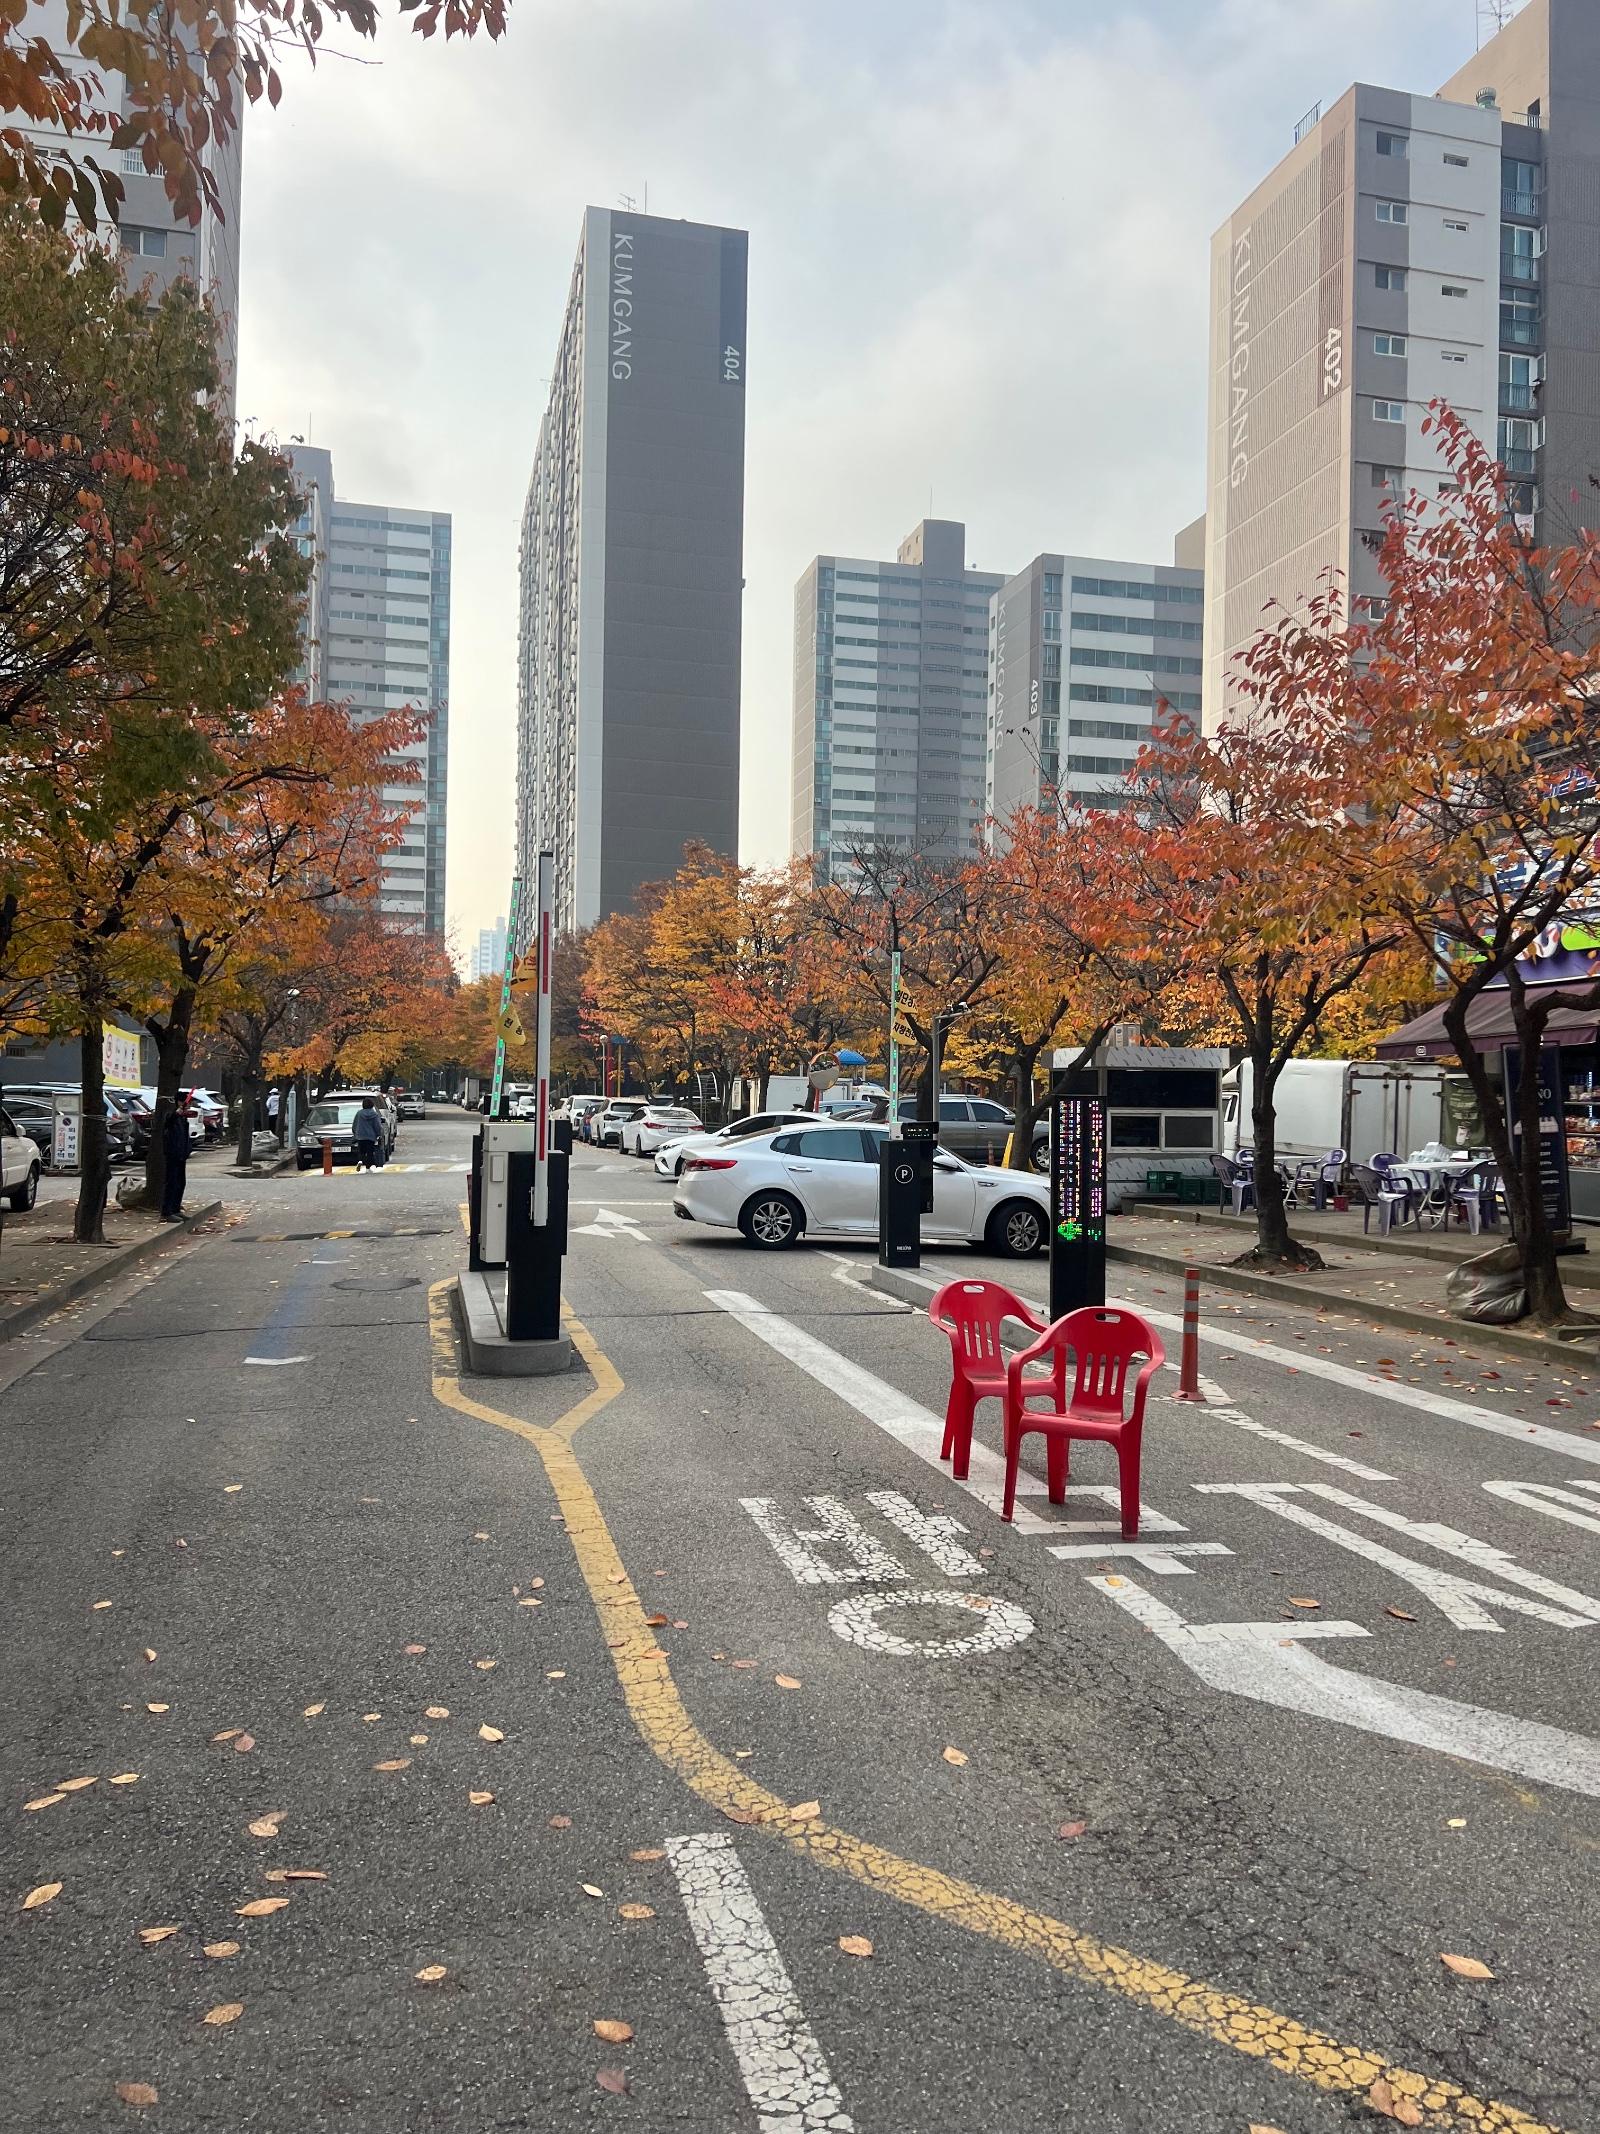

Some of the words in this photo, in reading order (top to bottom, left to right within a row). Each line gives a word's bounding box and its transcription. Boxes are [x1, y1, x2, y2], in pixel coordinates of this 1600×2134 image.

[612, 232, 634, 381] KUMGANG
[1231, 227, 1252, 489] KUMGANG
[723, 344, 740, 381] 404
[1323, 327, 1342, 396] 402
[995, 602, 1008, 751] KUMGANG
[1029, 678, 1040, 716] 403
